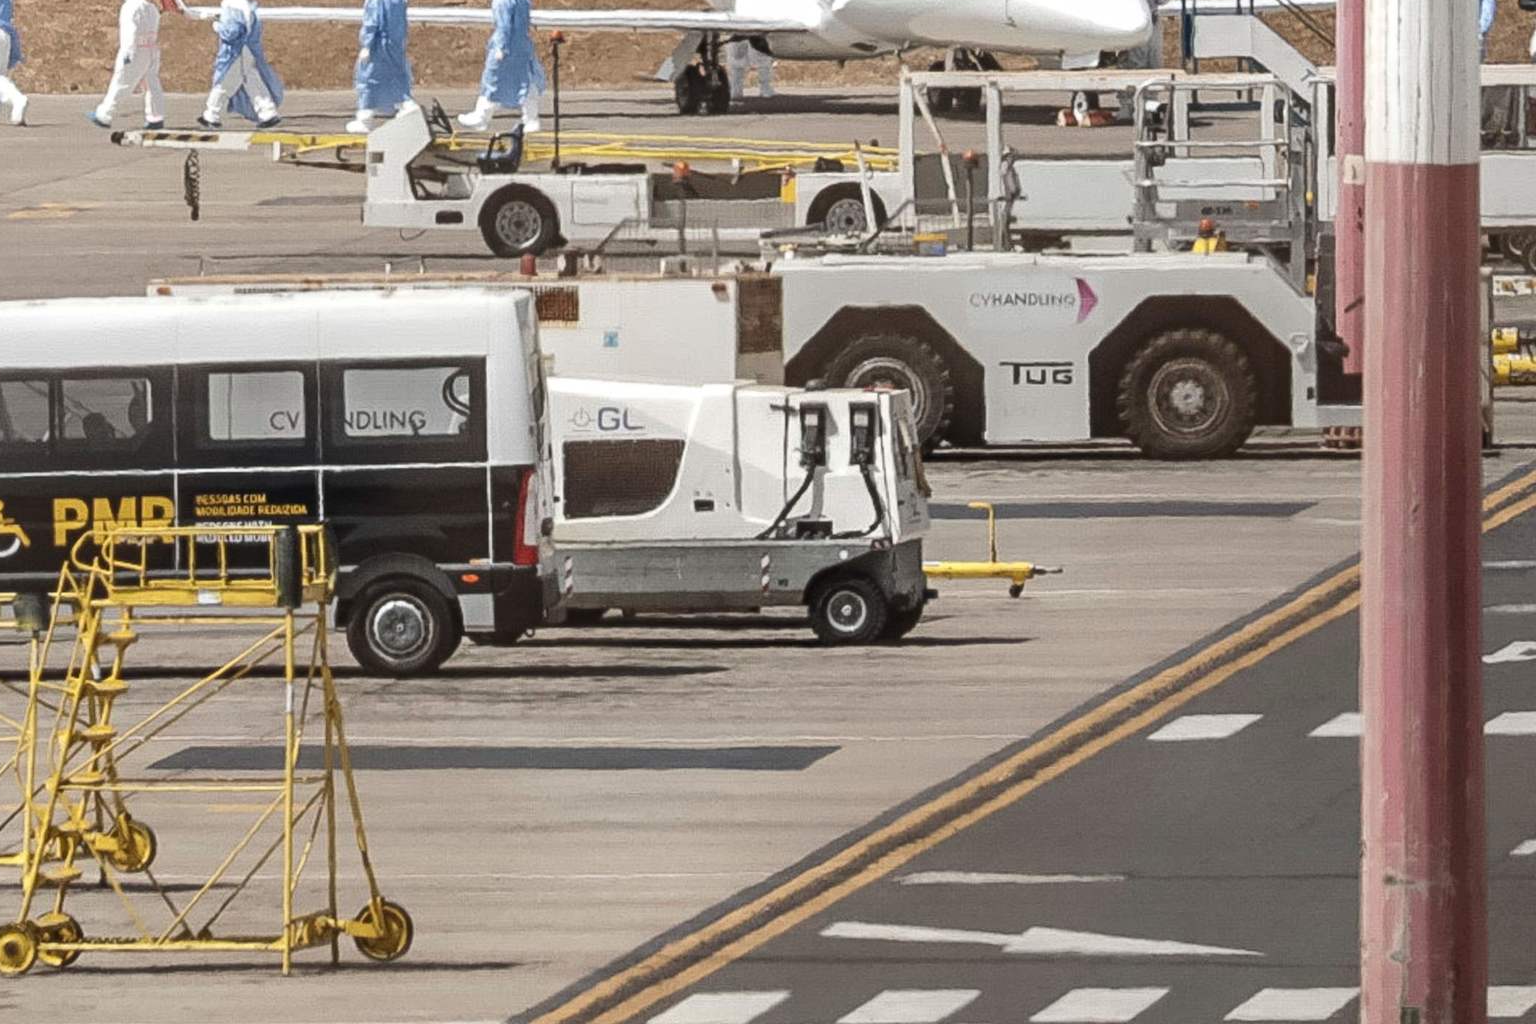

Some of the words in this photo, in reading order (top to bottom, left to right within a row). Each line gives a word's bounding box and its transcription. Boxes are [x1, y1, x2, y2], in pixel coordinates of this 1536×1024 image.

[999, 361, 1074, 385] TUG
[195, 494, 242, 505] PESSOAS
[244, 493, 266, 504] COM
[195, 505, 256, 516] MOBILIDADE
[258, 504, 308, 515] REDUZIDA
[54, 496, 175, 546] PMR
